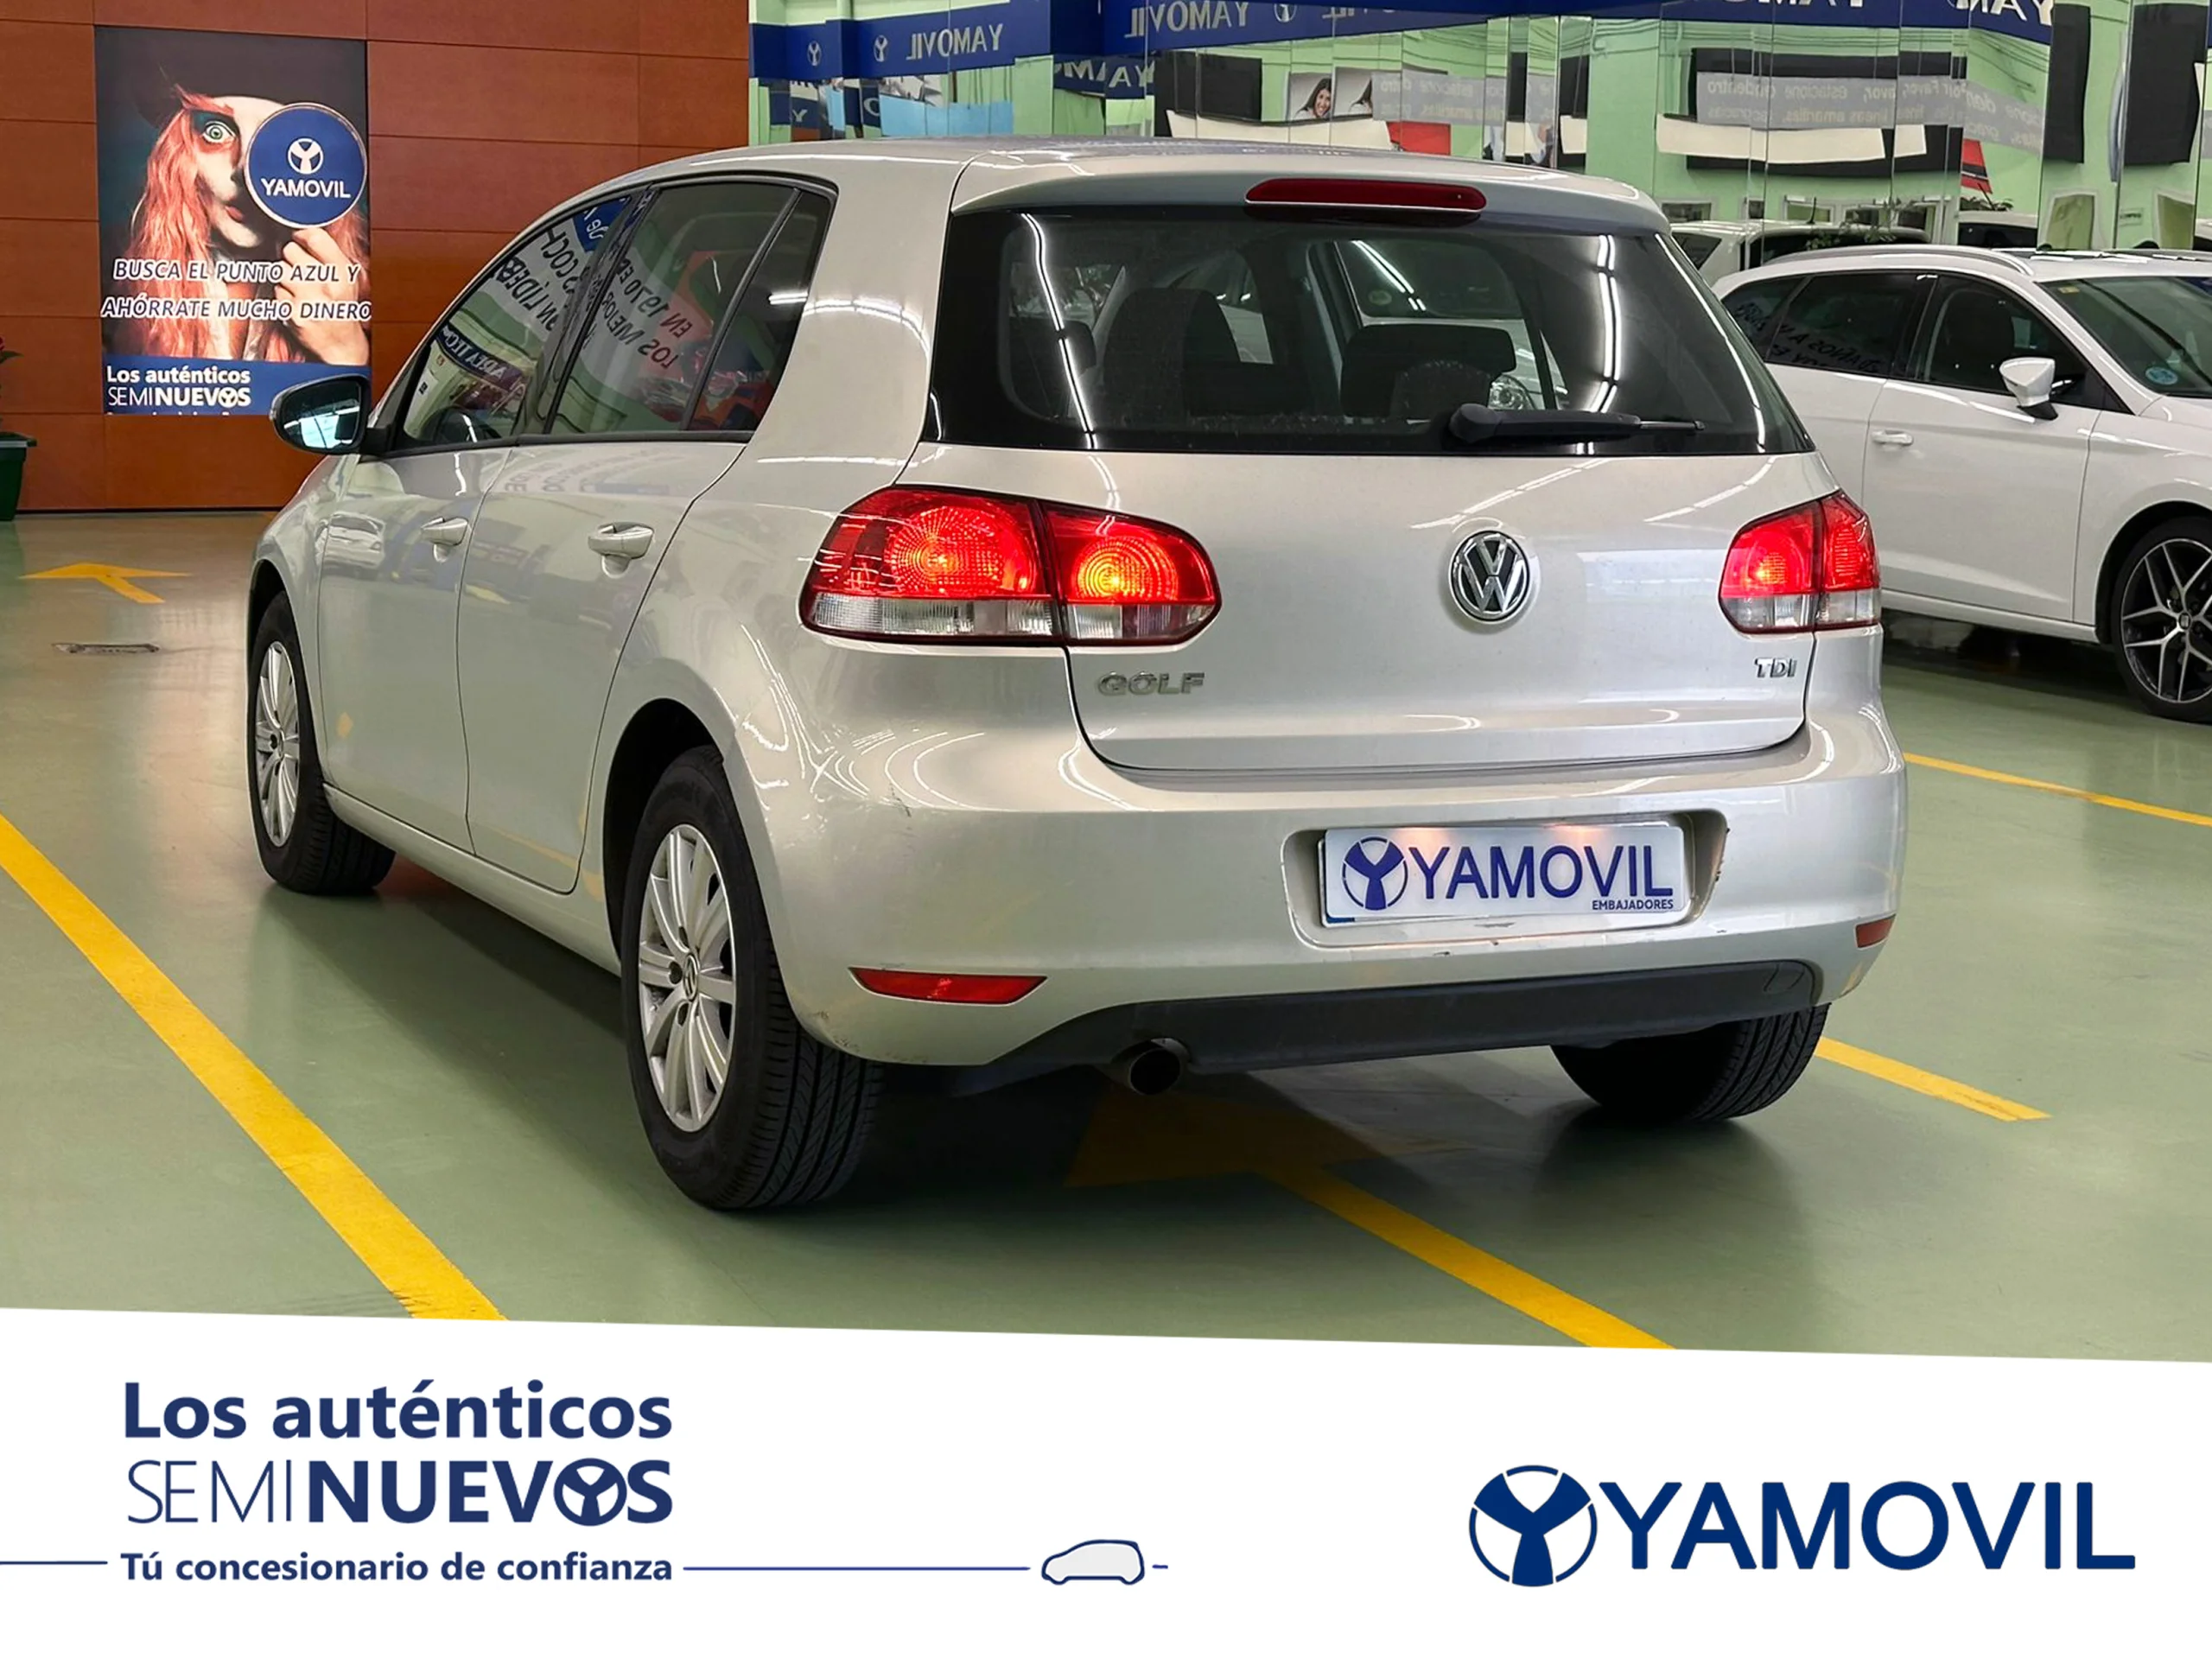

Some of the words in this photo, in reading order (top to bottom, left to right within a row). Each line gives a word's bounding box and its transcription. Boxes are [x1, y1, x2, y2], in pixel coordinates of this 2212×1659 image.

[261, 178, 351, 199] YAMOVIL
[113, 259, 181, 280] BUSCA
[188, 261, 208, 280] EL
[217, 261, 283, 282] PUNTO
[290, 263, 340, 282] AZUL
[347, 264, 360, 283] Y
[101, 294, 210, 318] AHÓRRATE
[218, 301, 292, 320] MUCHO
[300, 302, 372, 321] DINERO
[107, 365, 140, 383] Los
[145, 365, 251, 385] auténticos
[108, 386, 251, 408] SEMINUEVOS
[1754, 657, 1798, 678] TDI
[1097, 671, 1205, 696] GOLF
[1408, 843, 1674, 900] YAMOVIL
[1592, 898, 1675, 912] EMBAJADORES
